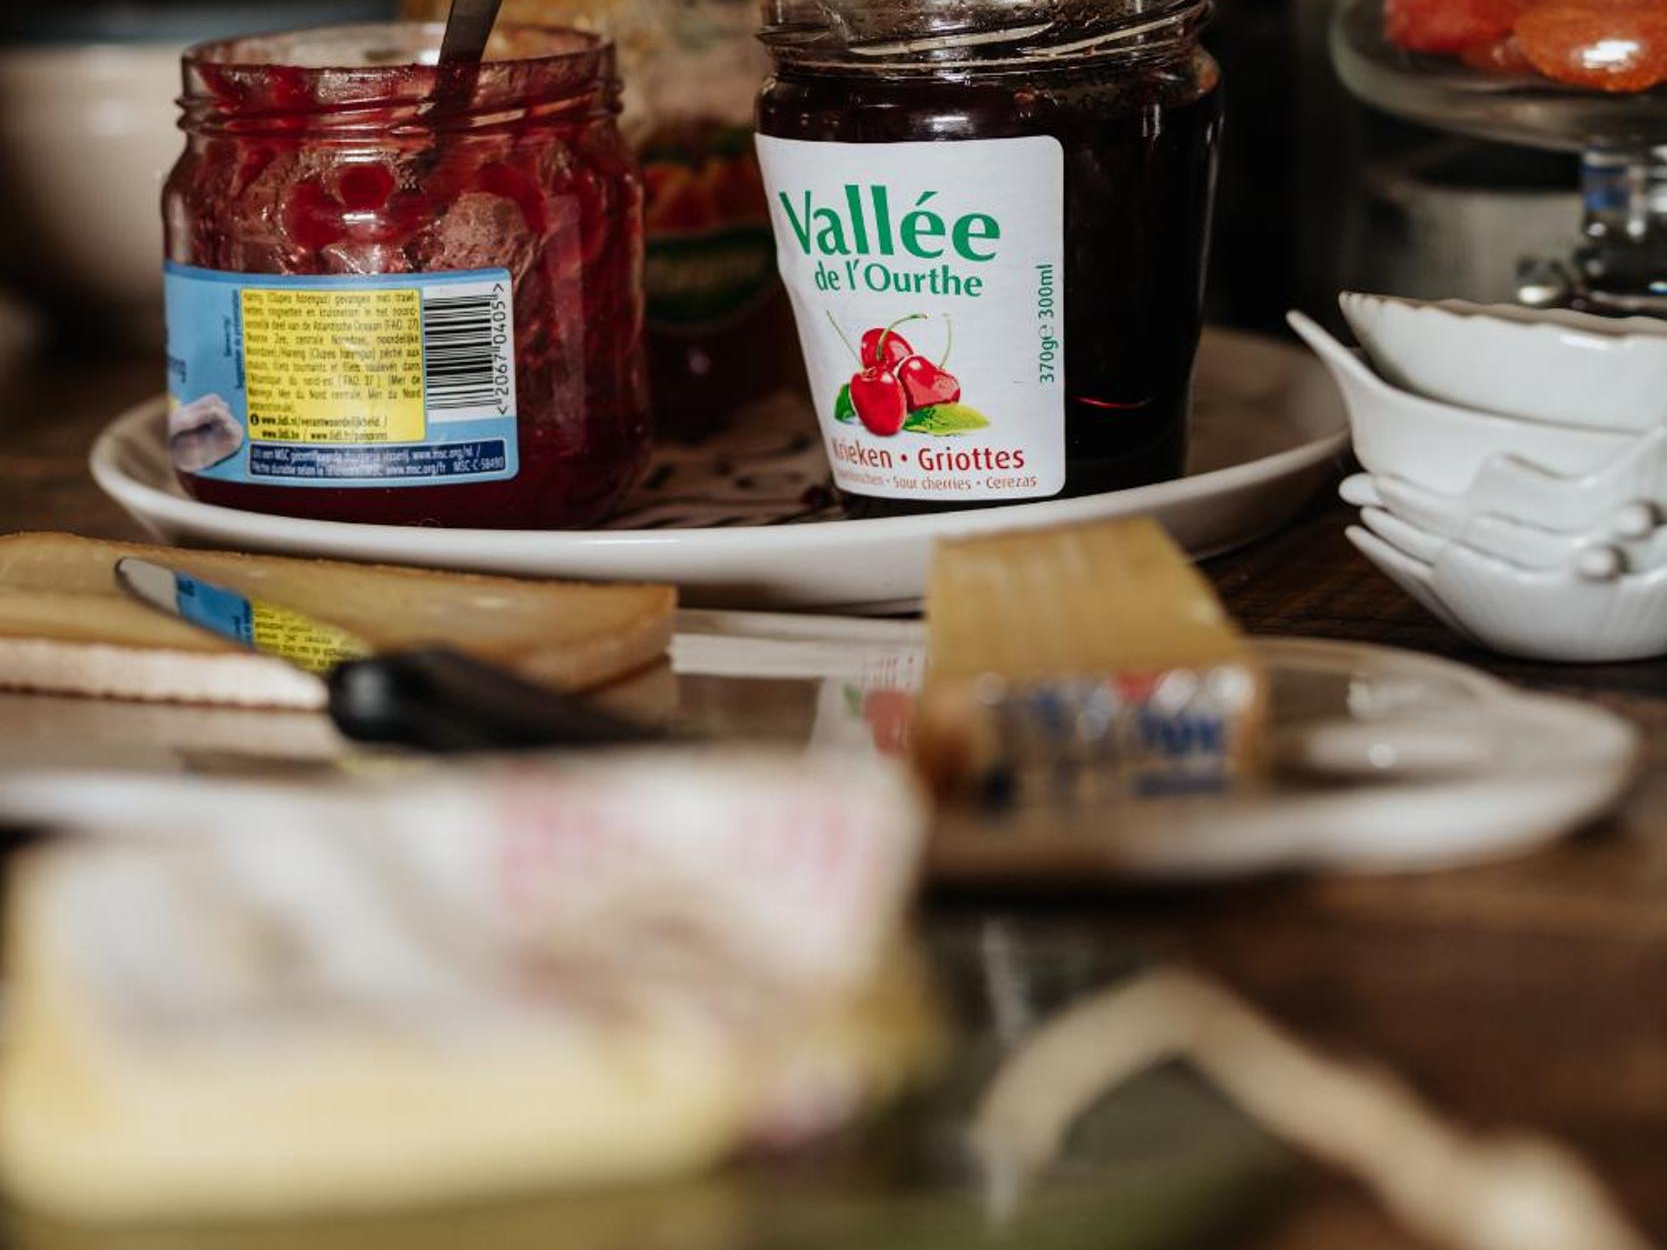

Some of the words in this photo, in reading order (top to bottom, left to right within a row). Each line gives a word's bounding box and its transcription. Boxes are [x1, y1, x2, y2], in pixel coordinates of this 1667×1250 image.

[778, 183, 1001, 262] Vallée
[814, 260, 840, 292] de
[845, 258, 984, 298] l'Ourthe
[1035, 264, 1054, 319] 300ml
[918, 446, 1025, 471] Griottes
[892, 475, 918, 489] Sour
[922, 476, 971, 491] cherries
[986, 476, 1037, 490] Cerezas
